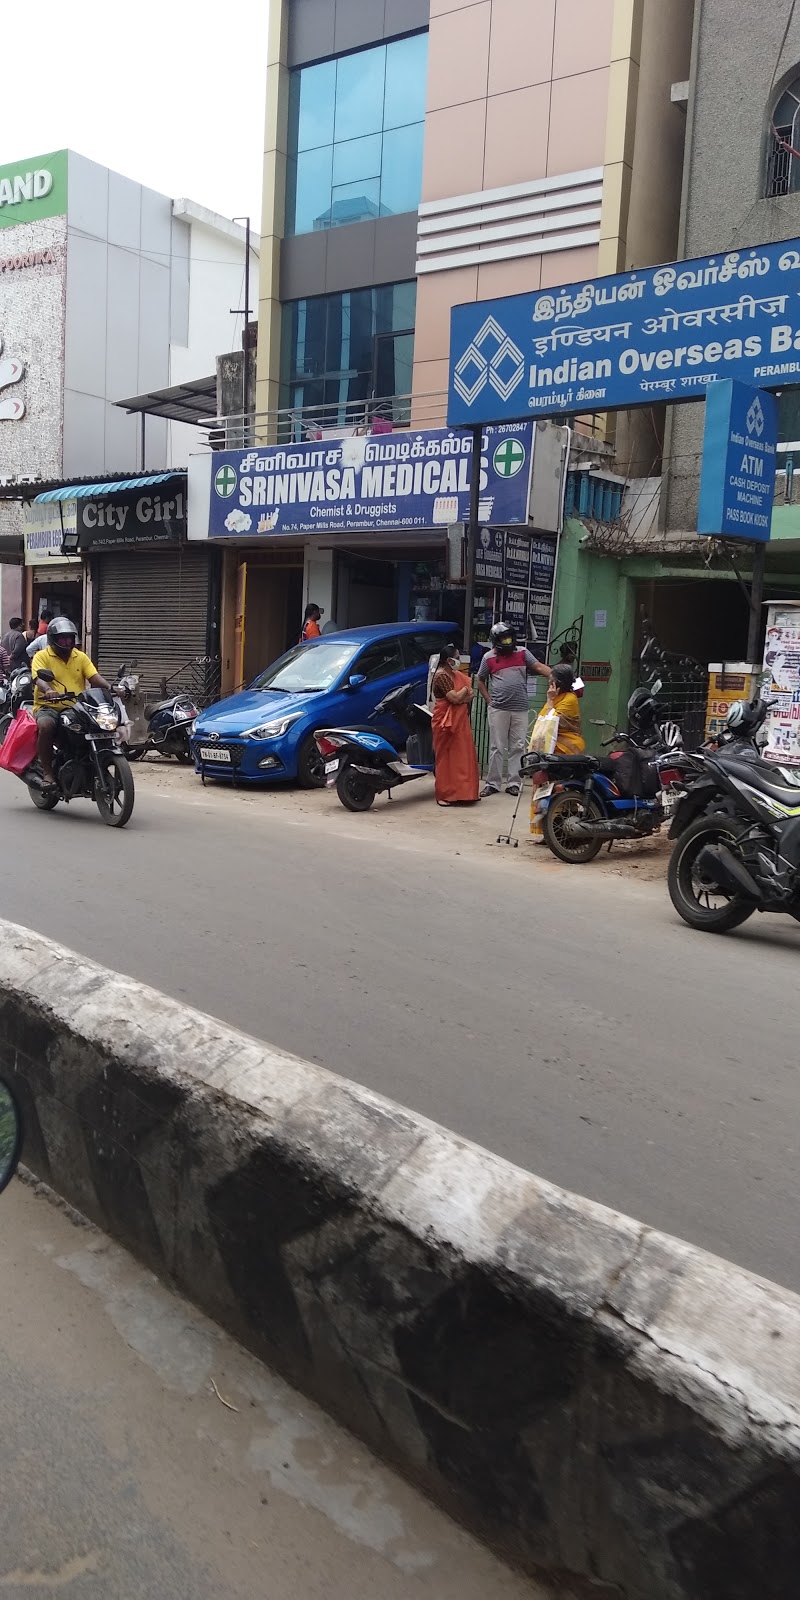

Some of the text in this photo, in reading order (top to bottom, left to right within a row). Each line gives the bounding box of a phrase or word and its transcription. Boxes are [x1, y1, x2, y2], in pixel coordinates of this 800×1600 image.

[532, 274, 647, 323] இந்தியன்
[532, 321, 634, 358] इण्डियन
[529, 355, 612, 388] Indian
[618, 335, 762, 375] Overseas
[527, 386, 607, 409] பெரம்பூர் கிளை
[730, 431, 744, 446] Indian
[744, 435, 764, 452] Overseas
[740, 454, 764, 478] ATM
[239, 455, 489, 508] SRINIVASA MEDICALS
[729, 475, 770, 495] CASH DEPOSIT
[309, 502, 397, 518] Chemist & Druggists
[736, 491, 763, 507] MACHINE
[82, 503, 129, 530] City
[135, 493, 188, 523] Girl
[726, 507, 769, 528] PASS BOOK KIOSK
[299, 521, 316, 531] Paper
[315, 520, 329, 530] Mills
[329, 519, 346, 529] Road,
[346, 518, 375, 529] Perambur,
